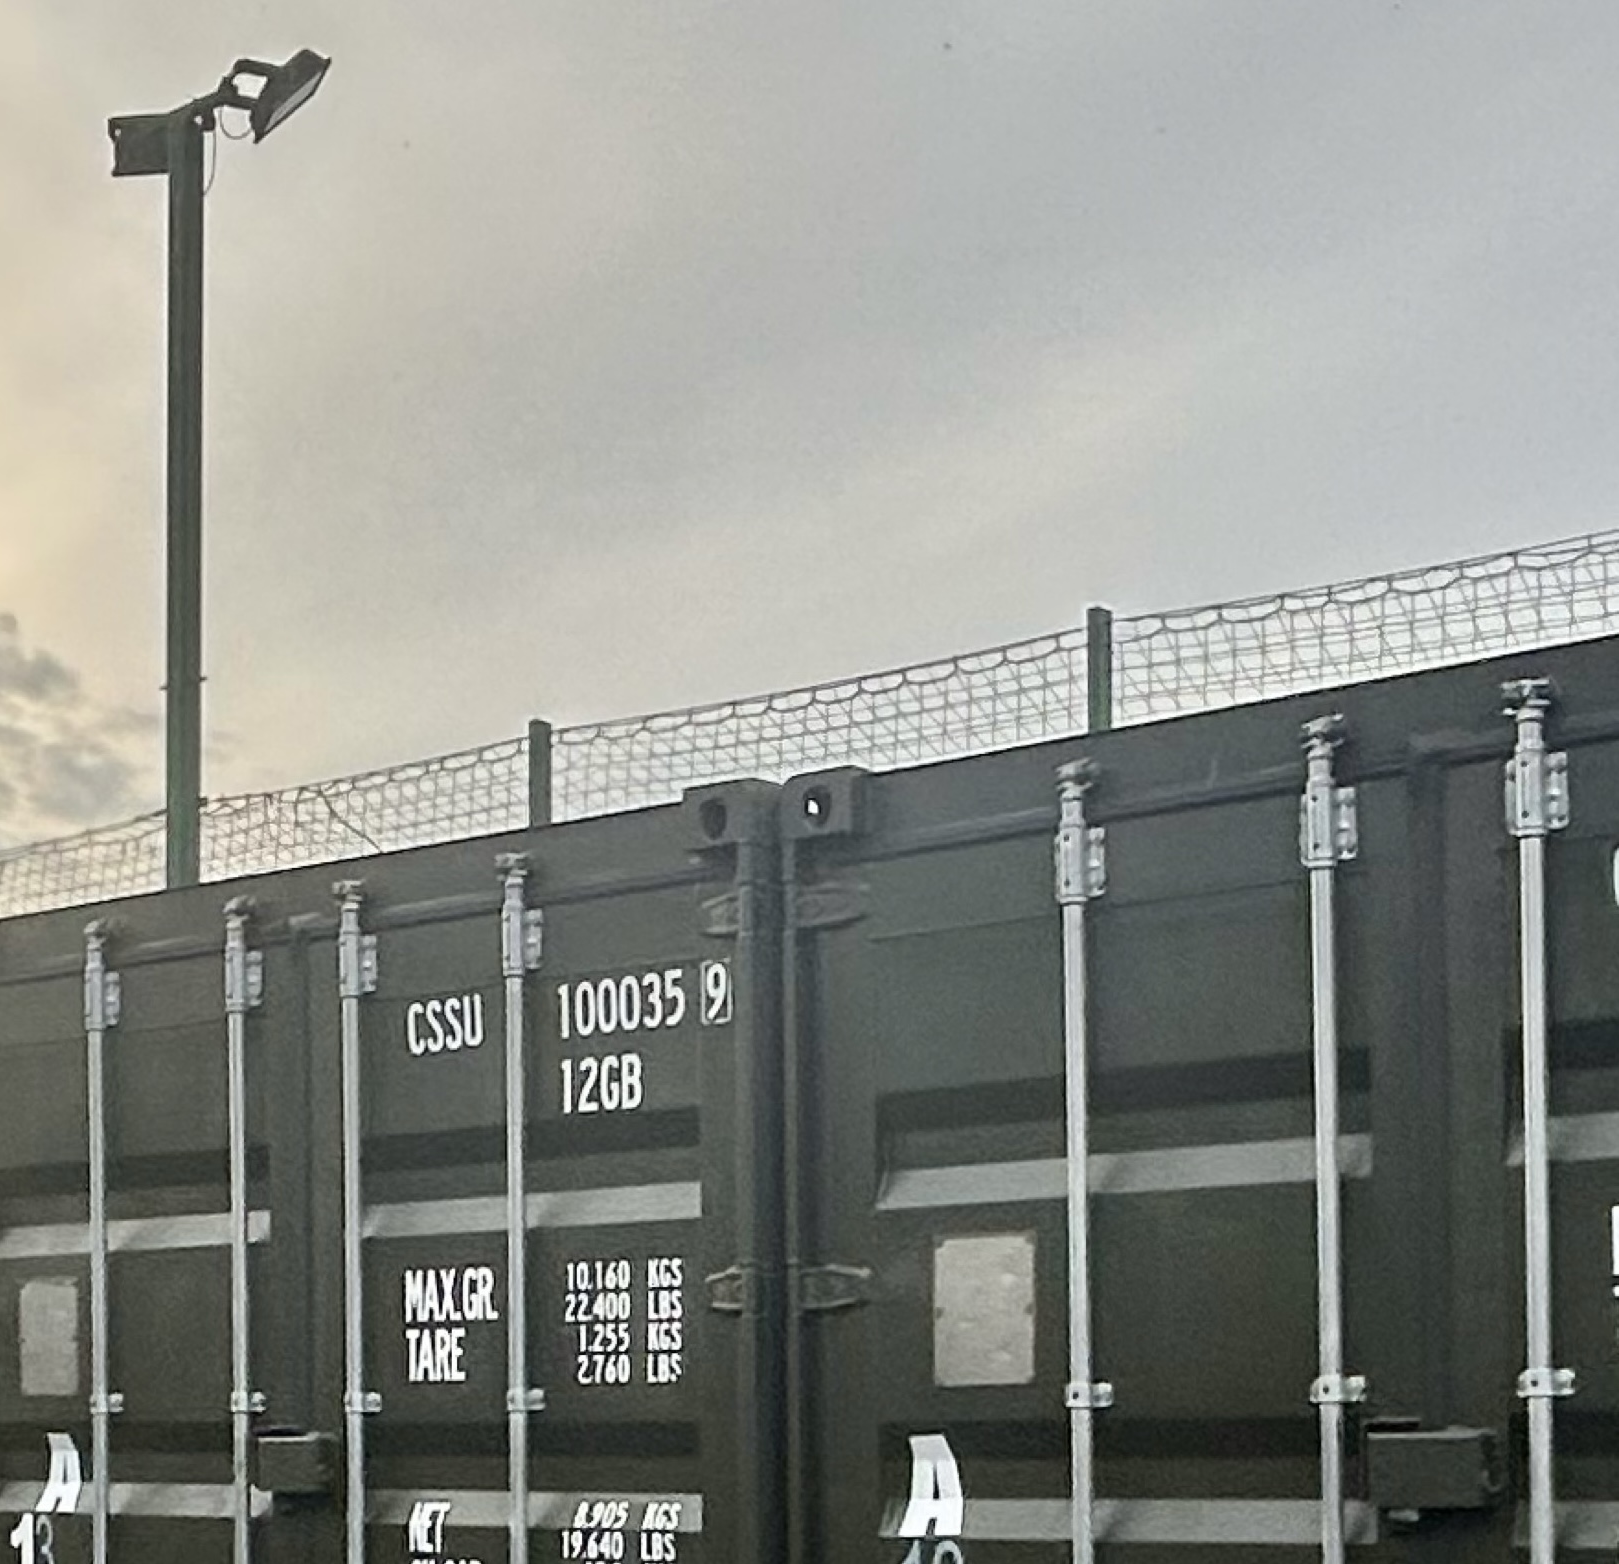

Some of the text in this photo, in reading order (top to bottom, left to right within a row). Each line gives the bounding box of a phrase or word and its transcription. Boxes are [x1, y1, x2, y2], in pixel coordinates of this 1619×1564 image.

[407, 962, 729, 1055] CSSU 100035 9
[562, 1053, 643, 1113] 12GB
[566, 1258, 683, 1291] 10.160 KGS
[565, 1290, 683, 1322] 22.400 LBS
[405, 1328, 466, 1381] TARE
[647, 1321, 683, 1350] KGS
[647, 1353, 683, 1383] LBS
[35, 1431, 82, 1513] A
[898, 1433, 964, 1536] A
[408, 1501, 451, 1553] NET
[562, 1530, 677, 1561] 19.640 LBS
